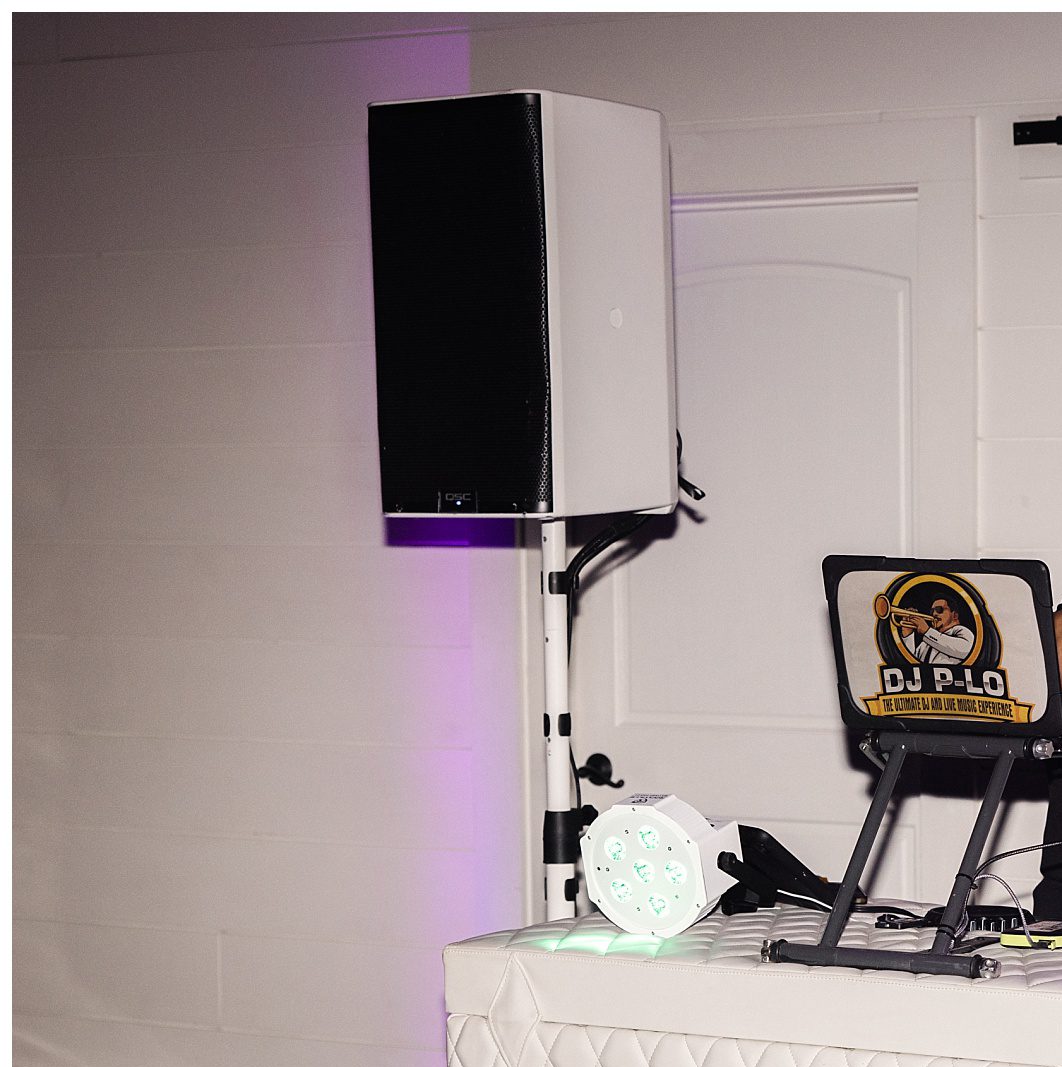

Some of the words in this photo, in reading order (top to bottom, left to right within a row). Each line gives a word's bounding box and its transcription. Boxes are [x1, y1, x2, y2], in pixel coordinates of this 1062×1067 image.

[883, 666, 922, 693] DJ
[933, 667, 1005, 697] P-LO
[882, 698, 894, 712] THE
[893, 697, 921, 711] ULTIMATE
[921, 697, 930, 711] DJ
[931, 697, 943, 711] AND
[943, 697, 957, 712] LIVE
[957, 698, 977, 713] MUSIC
[977, 699, 1014, 718] EXPERIENCE
